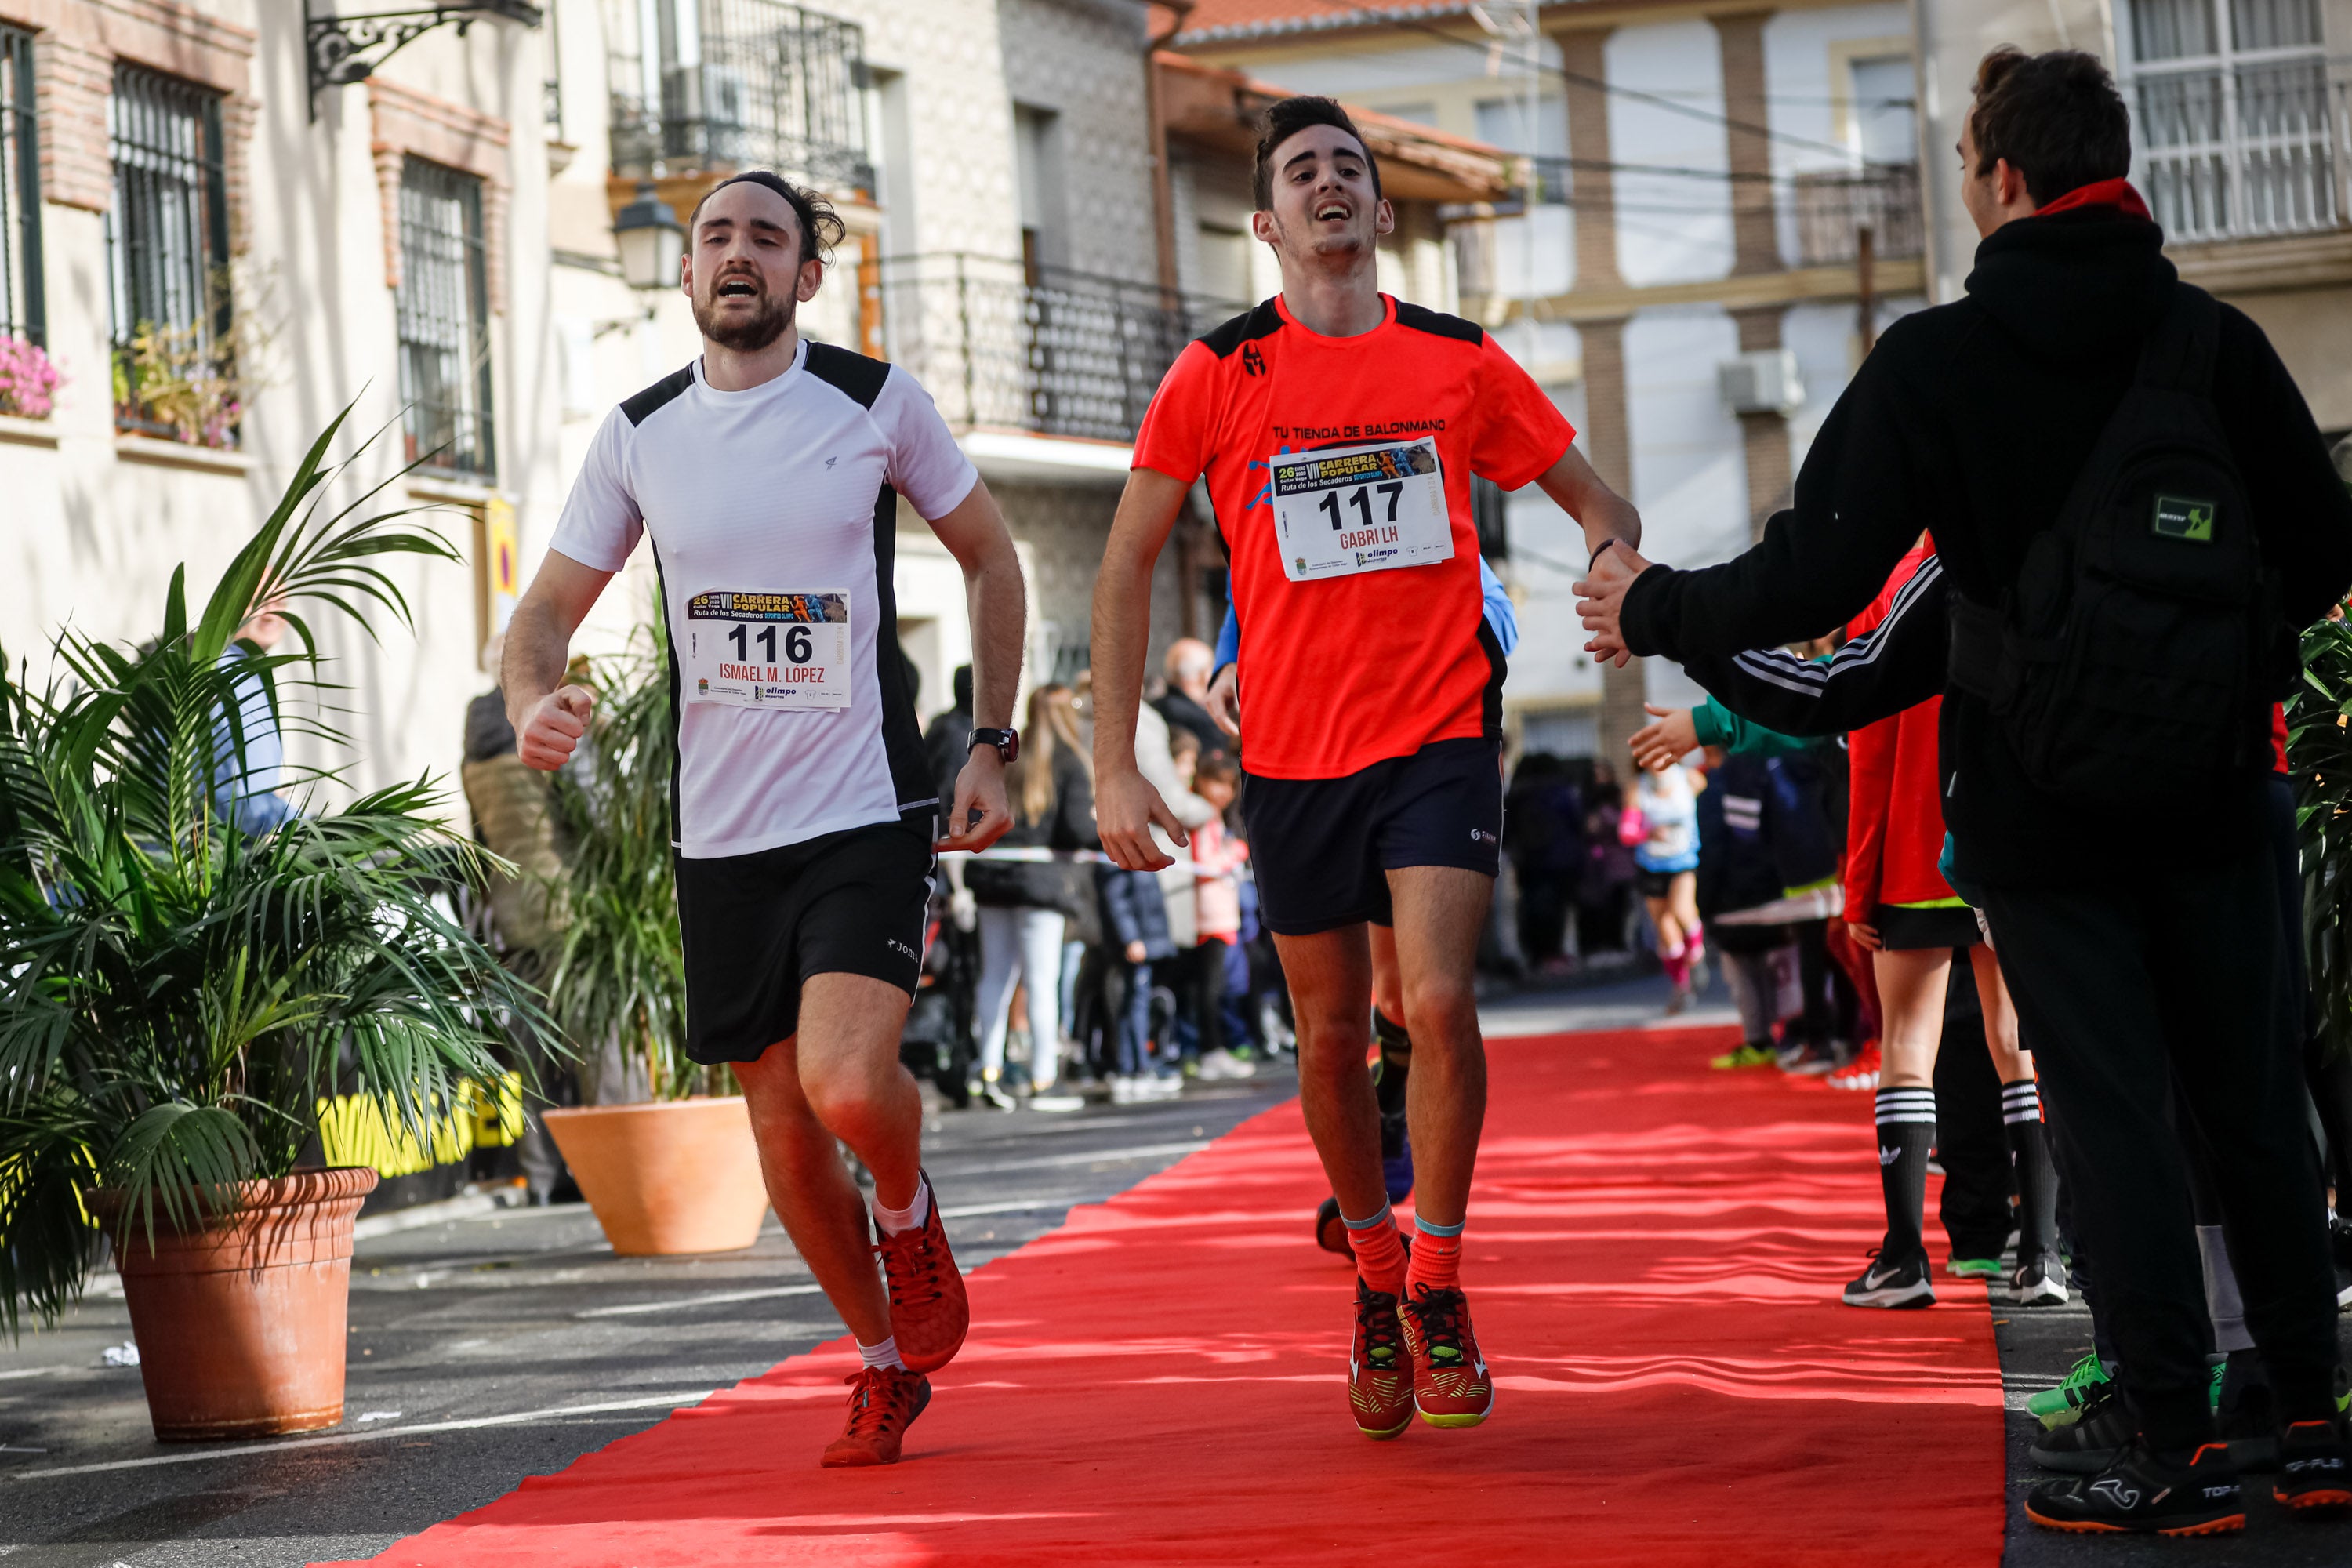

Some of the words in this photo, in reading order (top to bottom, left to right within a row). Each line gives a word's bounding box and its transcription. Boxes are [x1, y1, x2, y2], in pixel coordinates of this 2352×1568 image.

[1272, 426, 1289, 438] TU
[1292, 426, 1340, 439] TIENDA
[1344, 426, 1360, 437] DE
[1365, 419, 1446, 437] BALONMANO
[1319, 454, 1377, 470] CARRERA
[1279, 466, 1295, 479] 26
[1306, 463, 1320, 480] VII
[1320, 463, 1377, 478] POPULAR
[1281, 484, 1297, 492] Ruta
[1319, 476, 1352, 486] Secaderos
[1319, 481, 1404, 531] 117
[1340, 528, 1380, 550] GABRI
[1381, 525, 1399, 543] LH
[1367, 549, 1398, 558] olimpo
[693, 595, 709, 605] 26
[720, 593, 732, 609] VII
[732, 593, 789, 604] CARRERA
[731, 610, 764, 619] Secaderos
[733, 603, 790, 612] POPULAR
[728, 623, 813, 664] 116
[720, 663, 764, 682] ISMAEL
[767, 666, 782, 683] M.
[786, 664, 825, 683] LÓPEZ
[766, 686, 797, 695] olimpo
